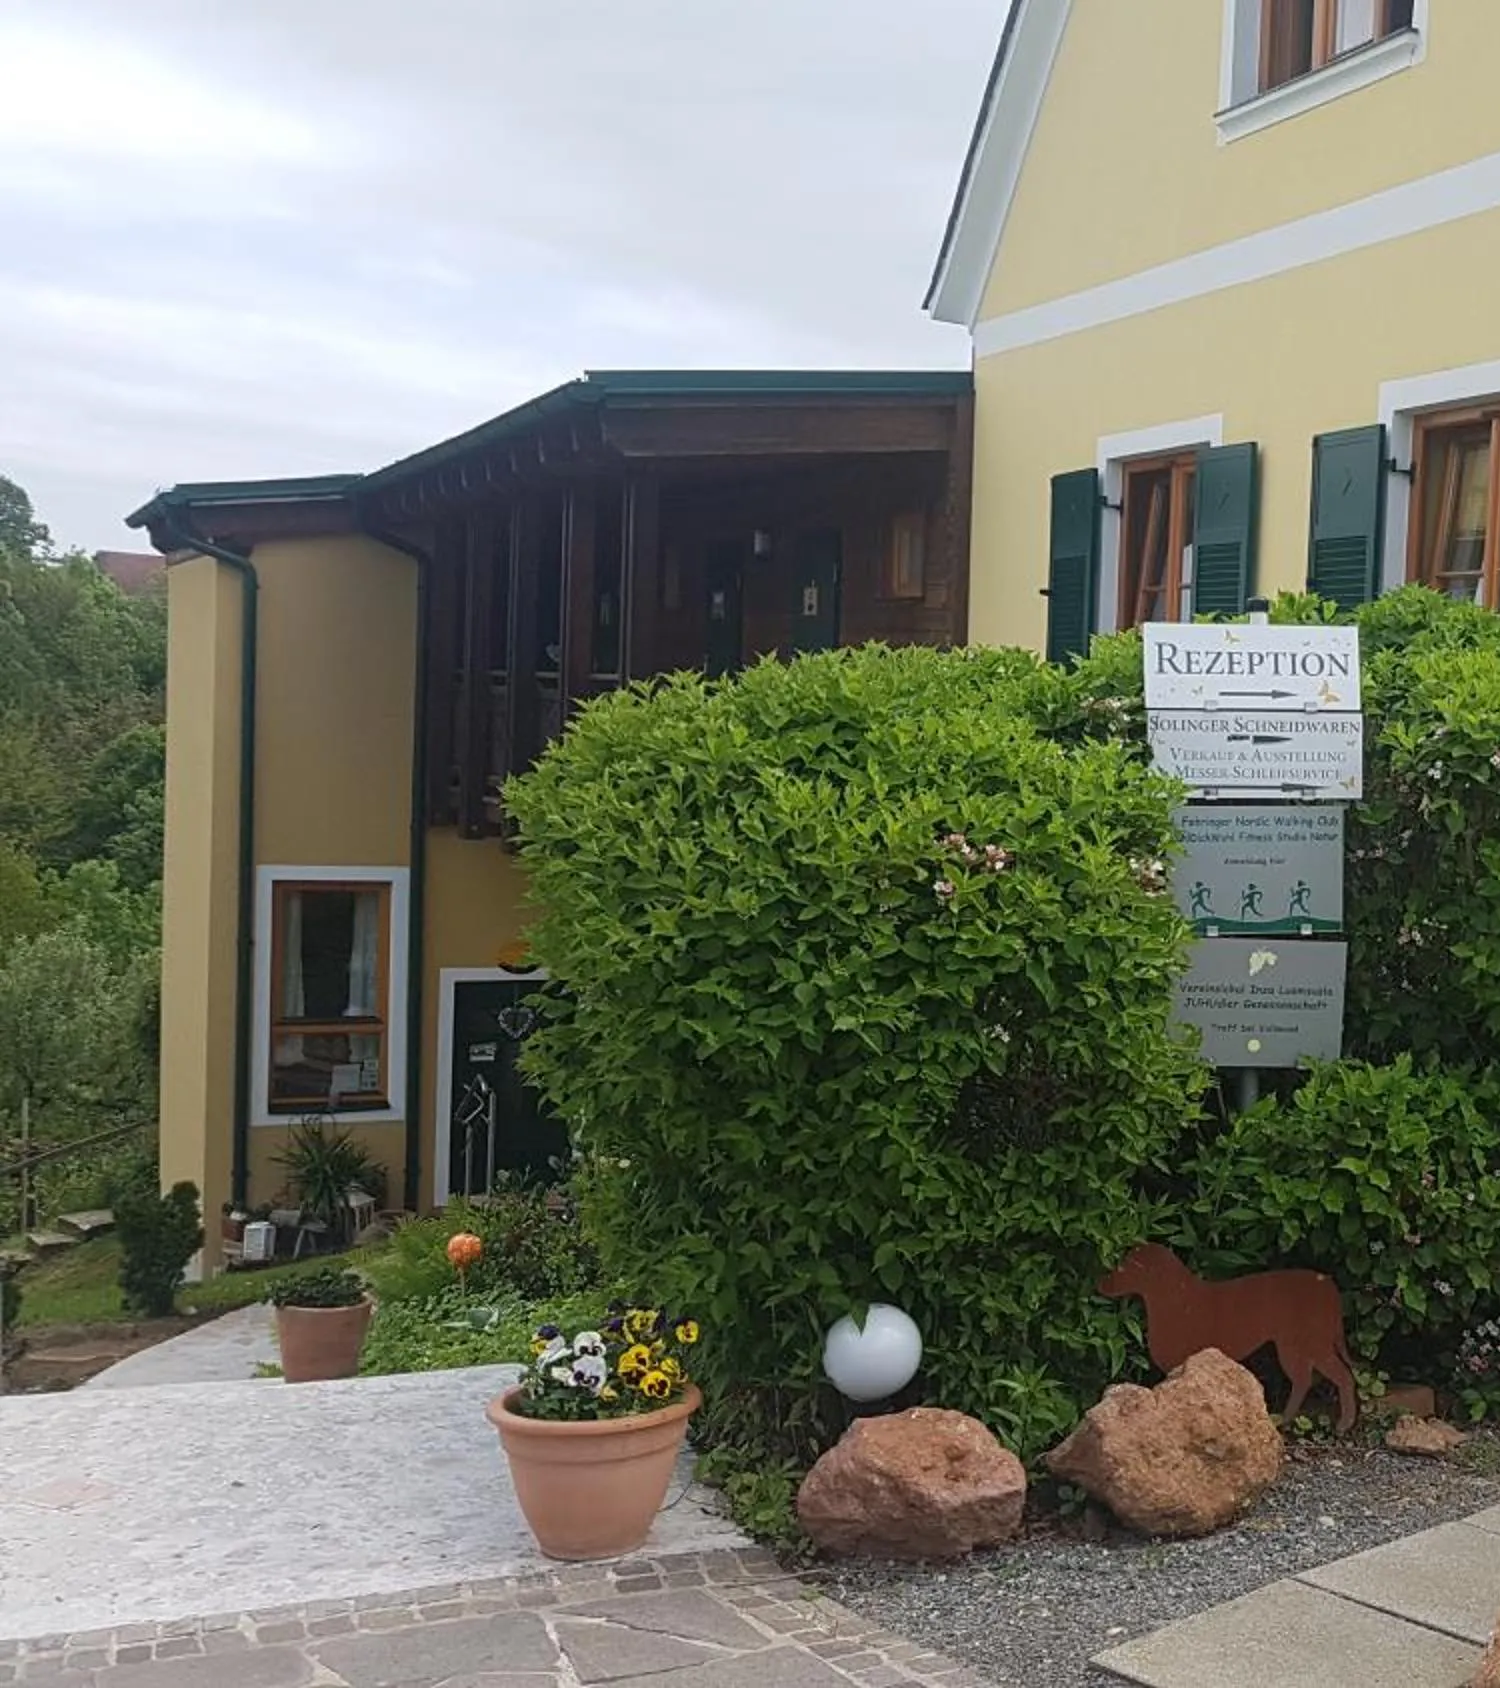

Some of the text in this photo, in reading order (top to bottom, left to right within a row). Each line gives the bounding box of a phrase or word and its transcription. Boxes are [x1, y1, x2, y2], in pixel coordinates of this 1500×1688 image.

[1155, 641, 1350, 678] REZEPTION
[1149, 715, 1361, 735] SOLINGER SCHNEIDWAREN
[1169, 747, 1348, 764] VERKAUF & AUSSTELLUNG
[1235, 815, 1270, 827] Nordic
[1273, 815, 1313, 829] Walking
